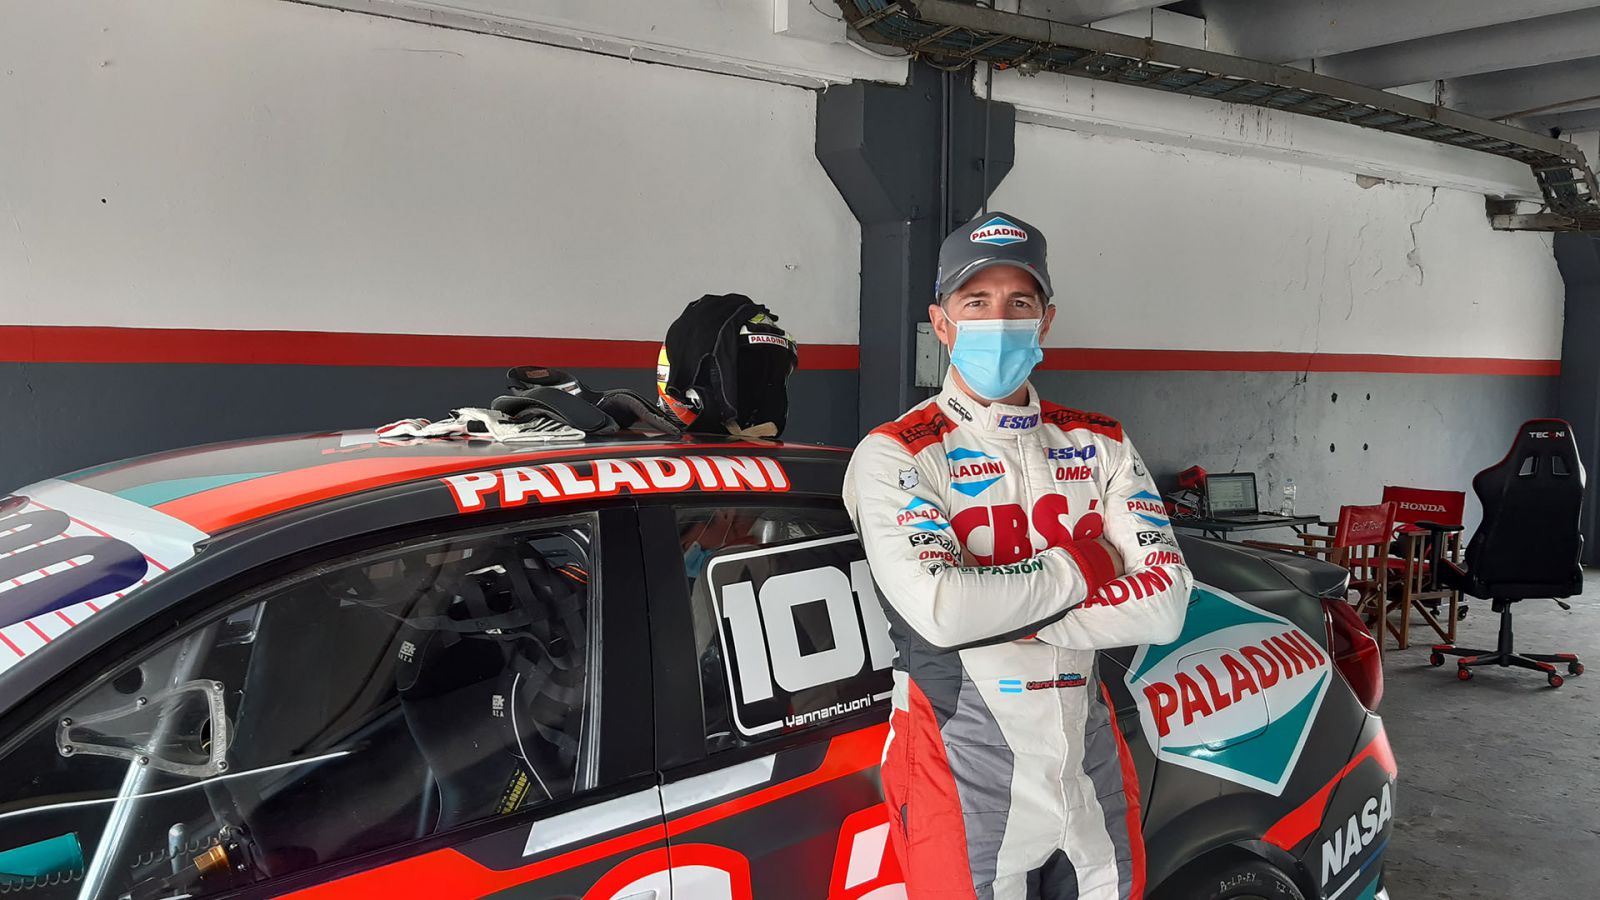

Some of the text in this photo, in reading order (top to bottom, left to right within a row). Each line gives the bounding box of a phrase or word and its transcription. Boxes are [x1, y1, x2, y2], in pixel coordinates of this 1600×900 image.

[972, 228, 1026, 240] PALADINI
[950, 460, 1006, 478] LADINI
[1056, 465, 1092, 480] OMB
[441, 455, 791, 513] PALADINI
[896, 508, 946, 526] PALAD
[1400, 501, 1447, 512] HONDA
[977, 558, 1044, 574] PASIÓN
[1071, 566, 1173, 609] ADINI
[722, 559, 897, 705] 101
[1143, 629, 1326, 738] PALADINI
[785, 693, 871, 728] Yannantuoni
[1321, 782, 1392, 888] NASA
